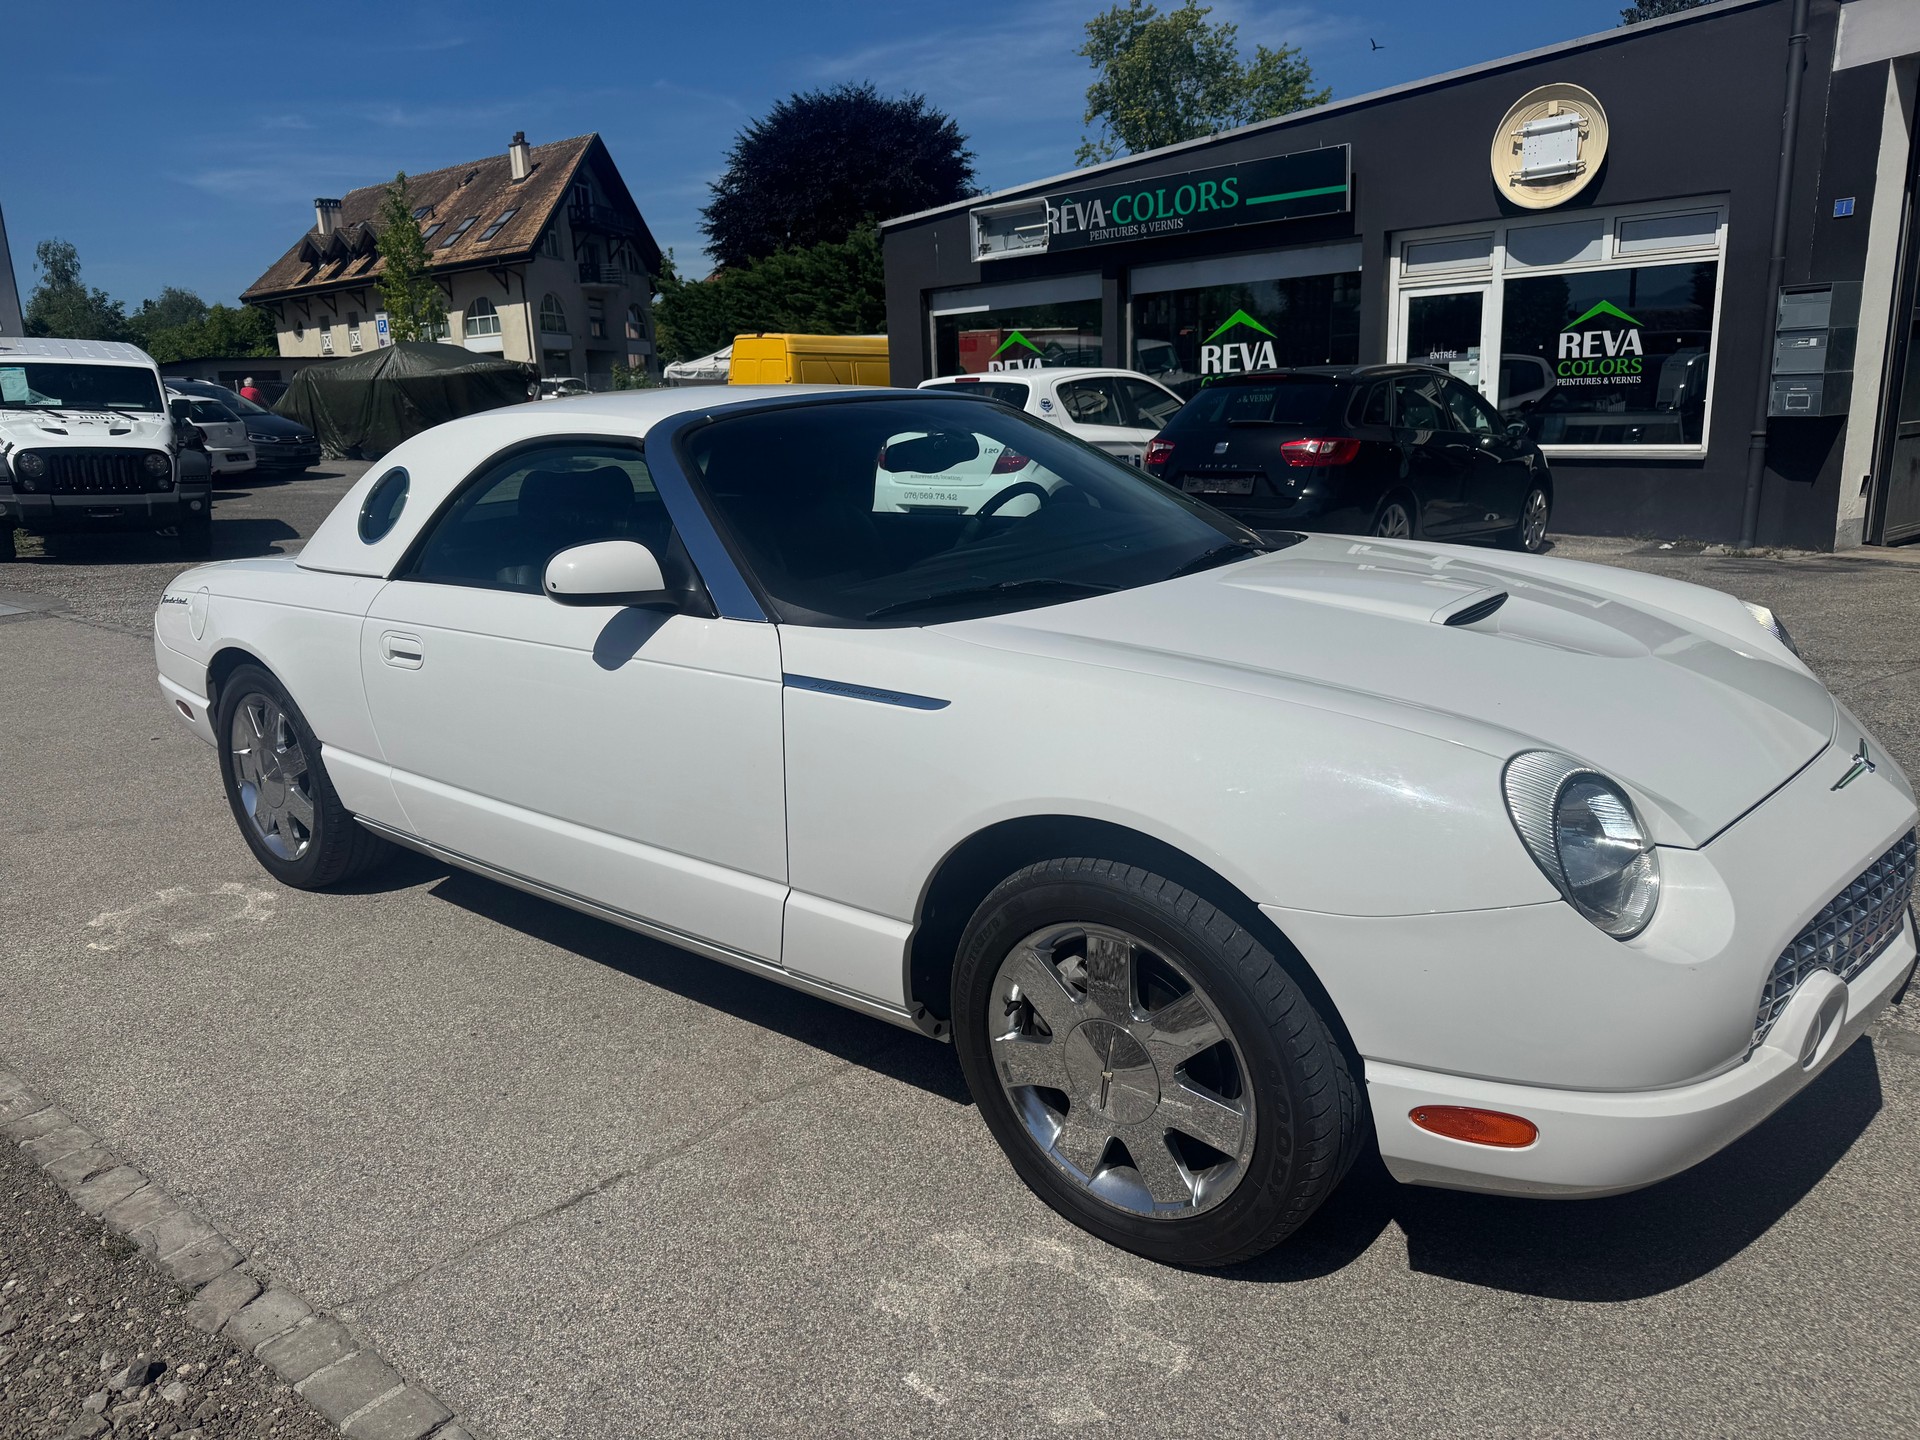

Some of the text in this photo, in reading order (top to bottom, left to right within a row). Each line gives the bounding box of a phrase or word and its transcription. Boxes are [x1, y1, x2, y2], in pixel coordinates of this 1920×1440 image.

[1089, 217, 1184, 242] PEINTURES & VERNIS
[1558, 329, 1643, 359] REVA
[1201, 340, 1278, 374] REVA
[1429, 349, 1457, 360] ENTRÉE
[1557, 357, 1643, 377] COLORS
[1556, 375, 1642, 387] PEINTURES & VERNIS
[982, 447, 999, 455] 120
[903, 491, 958, 501] 076/569.78.42
